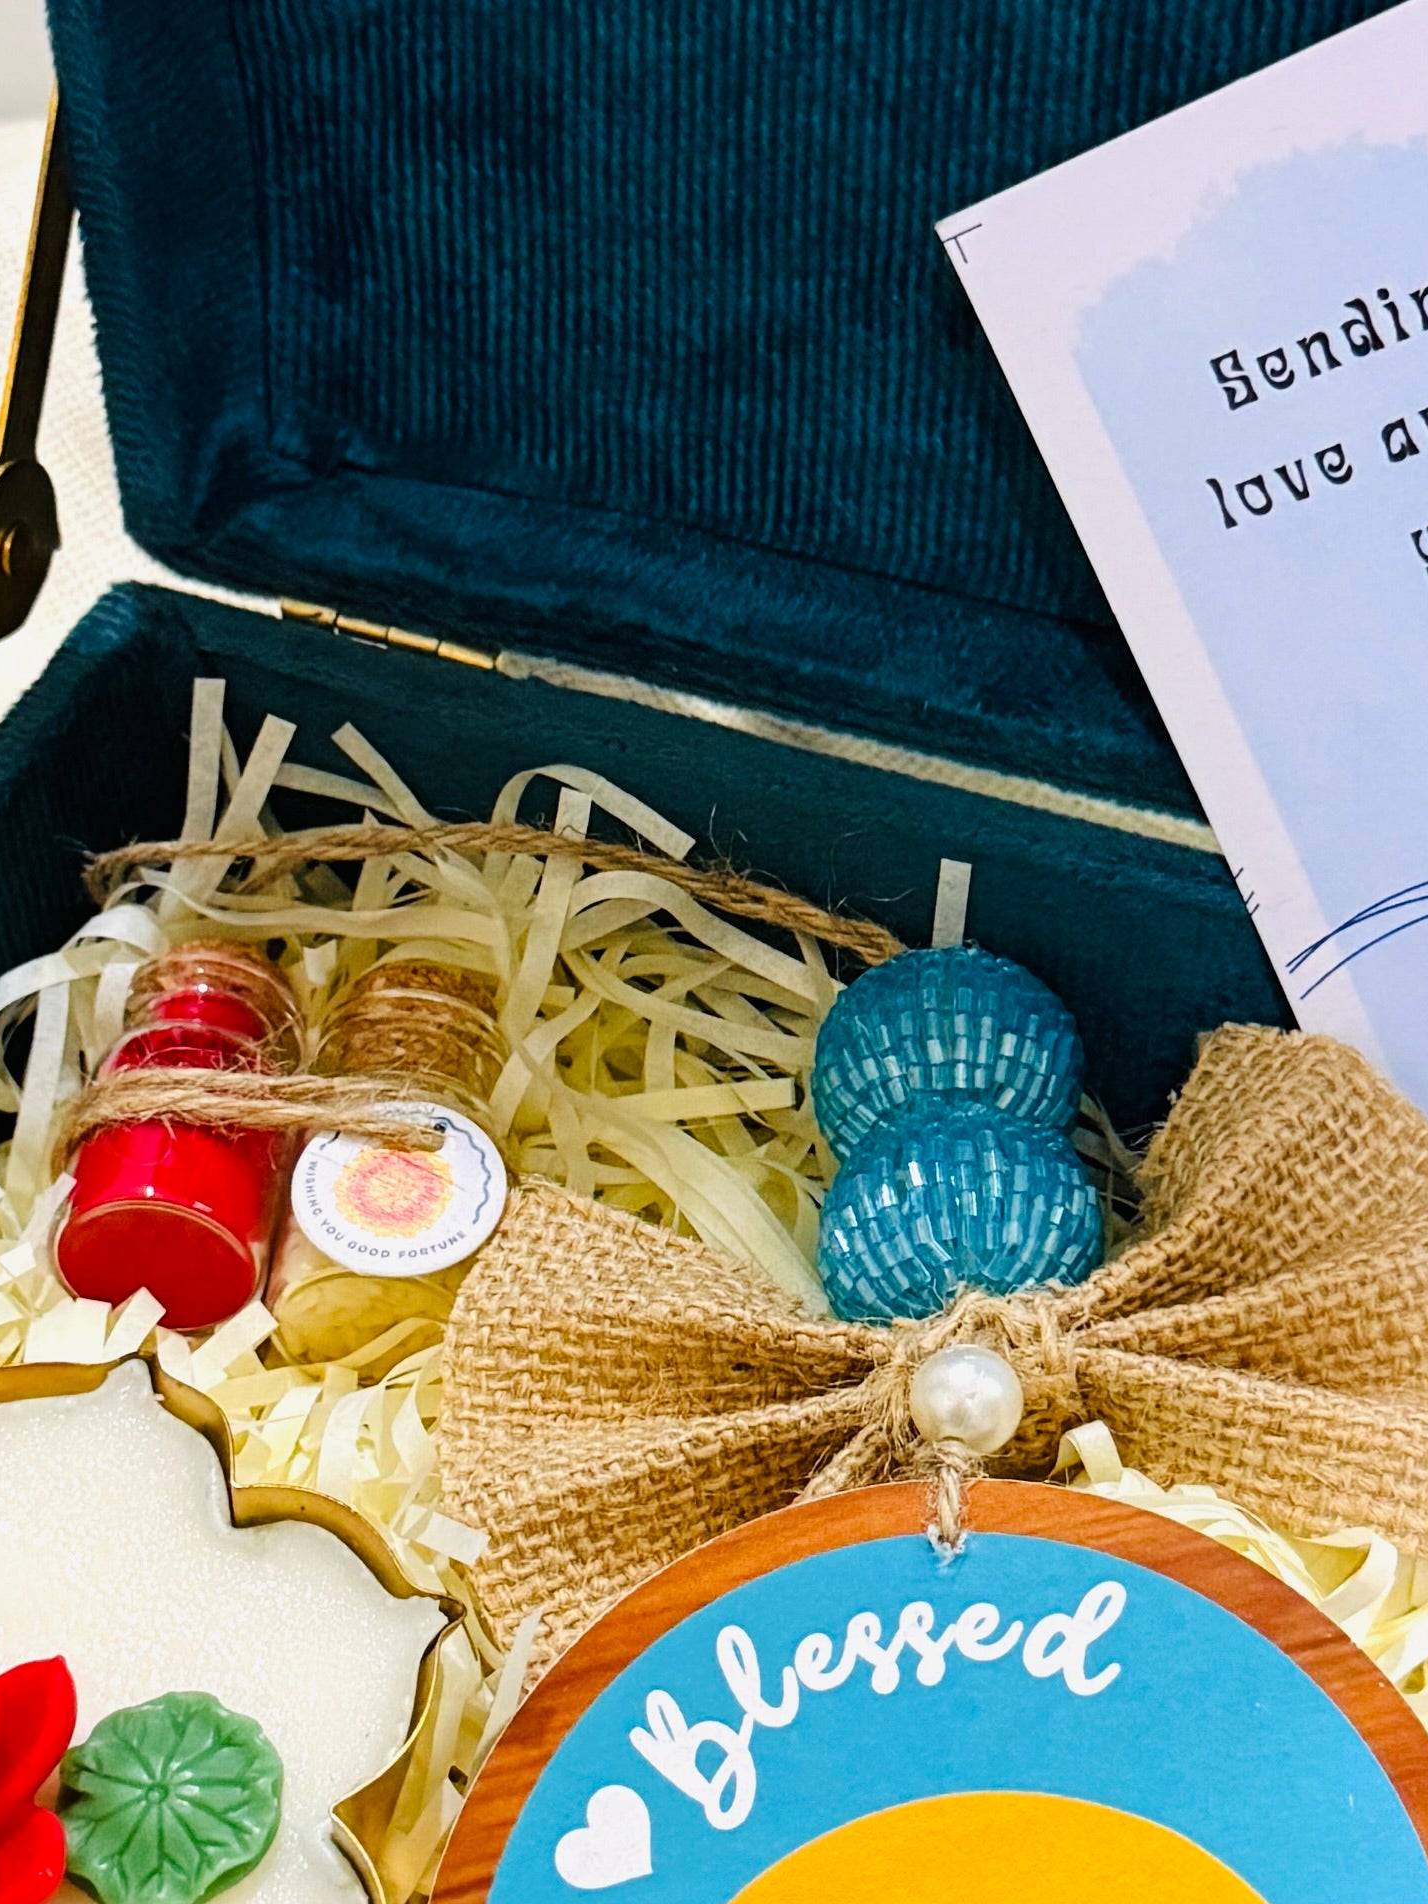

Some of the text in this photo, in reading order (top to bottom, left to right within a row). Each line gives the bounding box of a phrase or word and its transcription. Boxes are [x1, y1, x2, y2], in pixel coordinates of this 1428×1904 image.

[1206, 443, 1354, 529] love
[321, 1220, 346, 1241] YOU
[347, 1241, 390, 1258] GOOD
[398, 1230, 467, 1259] FORTUNE
[628, 1580, 1128, 1831] Blessed
